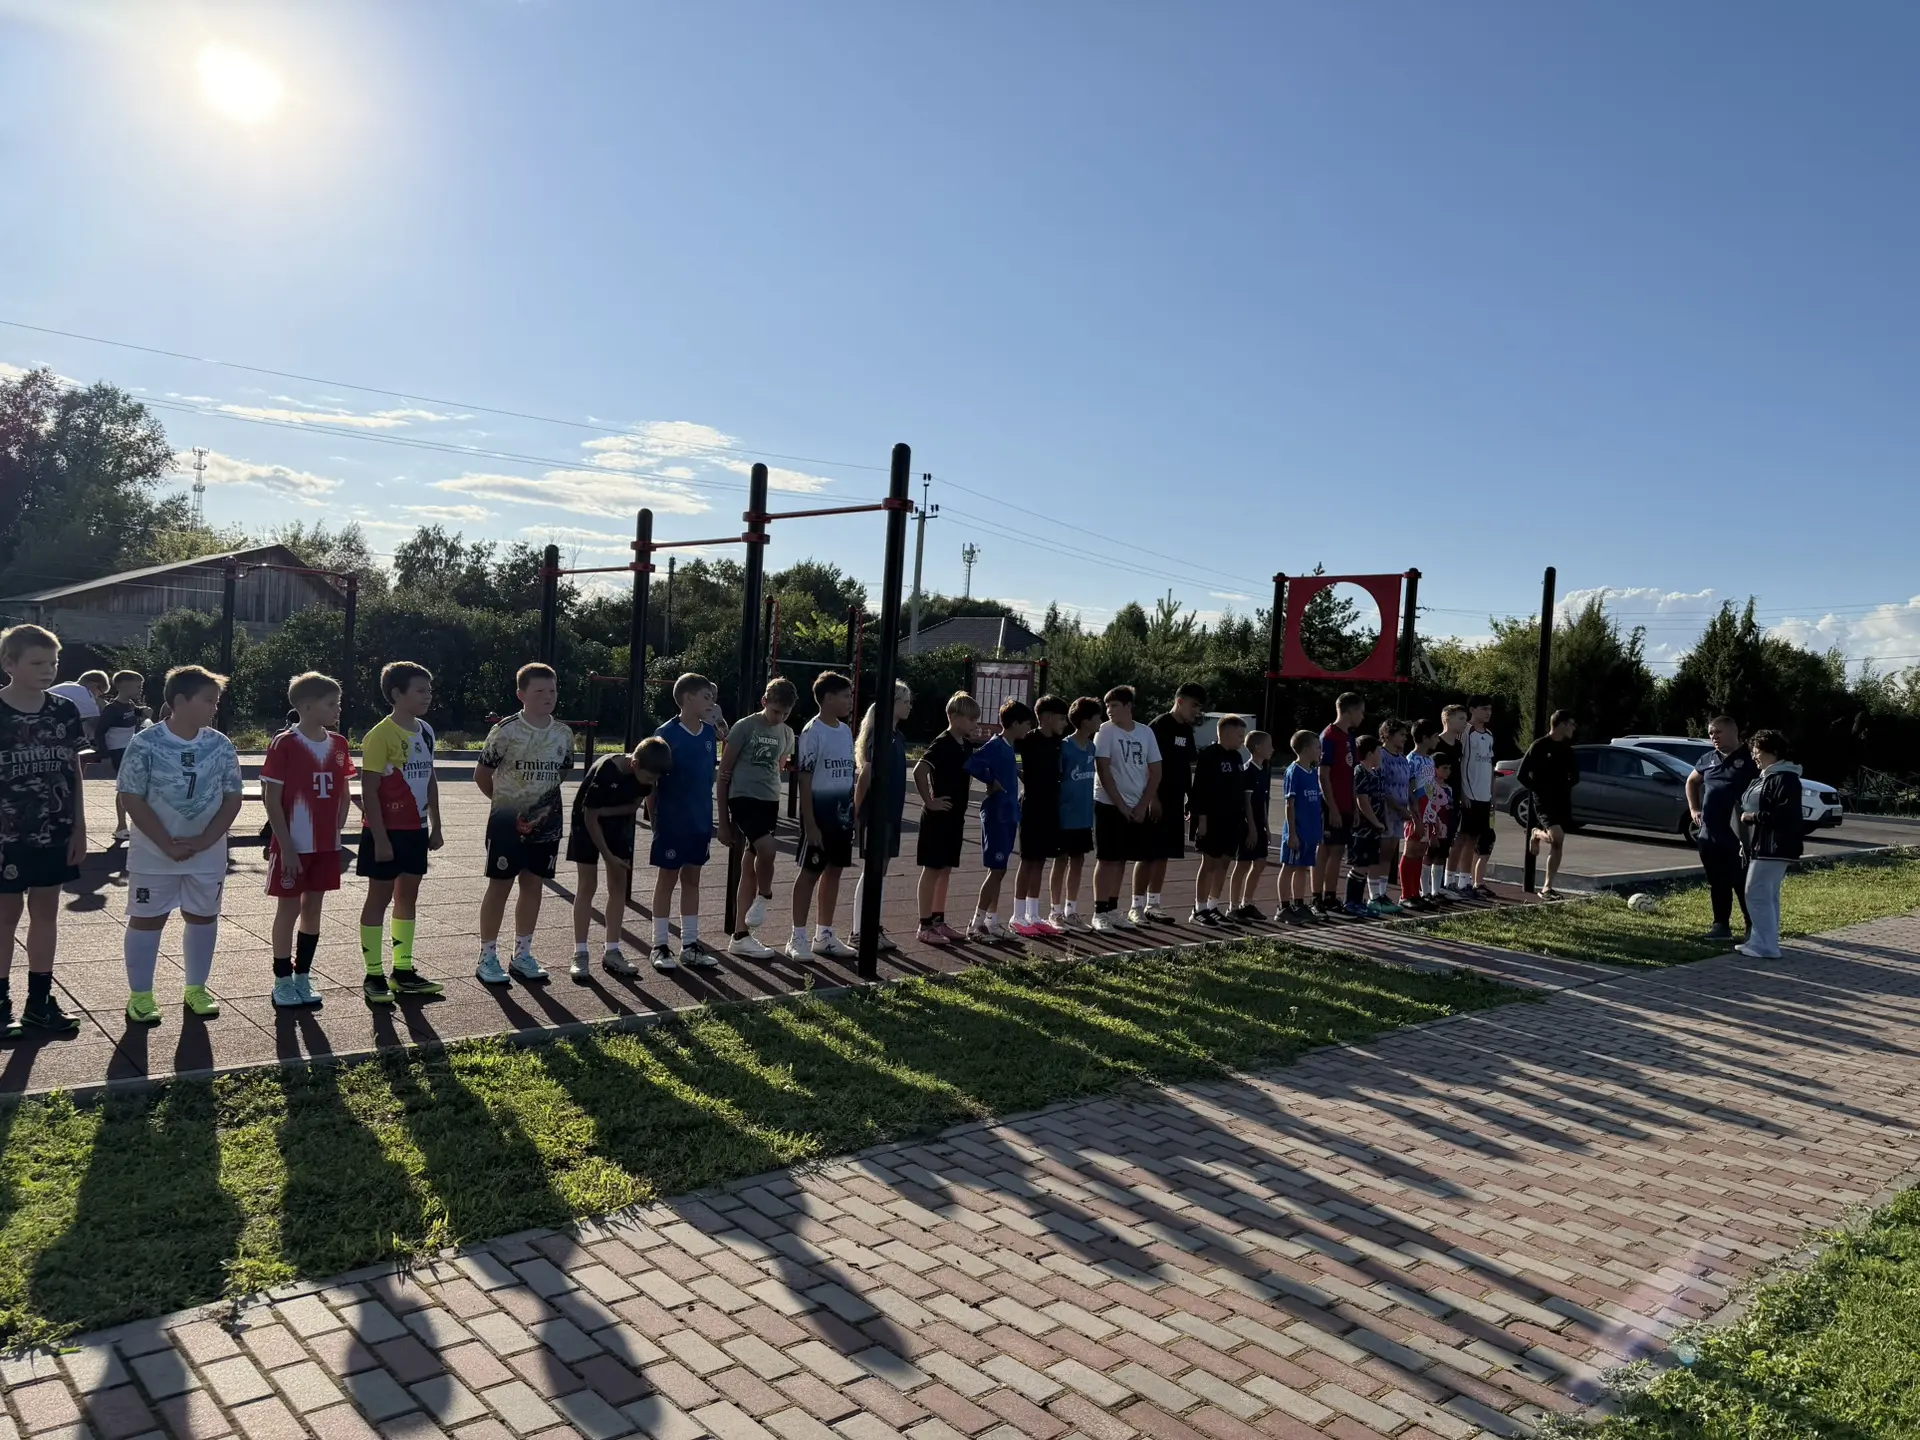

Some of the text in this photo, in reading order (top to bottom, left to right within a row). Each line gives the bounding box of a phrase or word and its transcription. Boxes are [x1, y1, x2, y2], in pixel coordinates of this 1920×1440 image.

[12, 760, 62, 776] FLY BETTER
[1221, 761, 1233, 773] 23
[523, 771, 559, 781] FLY BETTER
[182, 771, 197, 799] 7
[215, 881, 223, 901] 7
